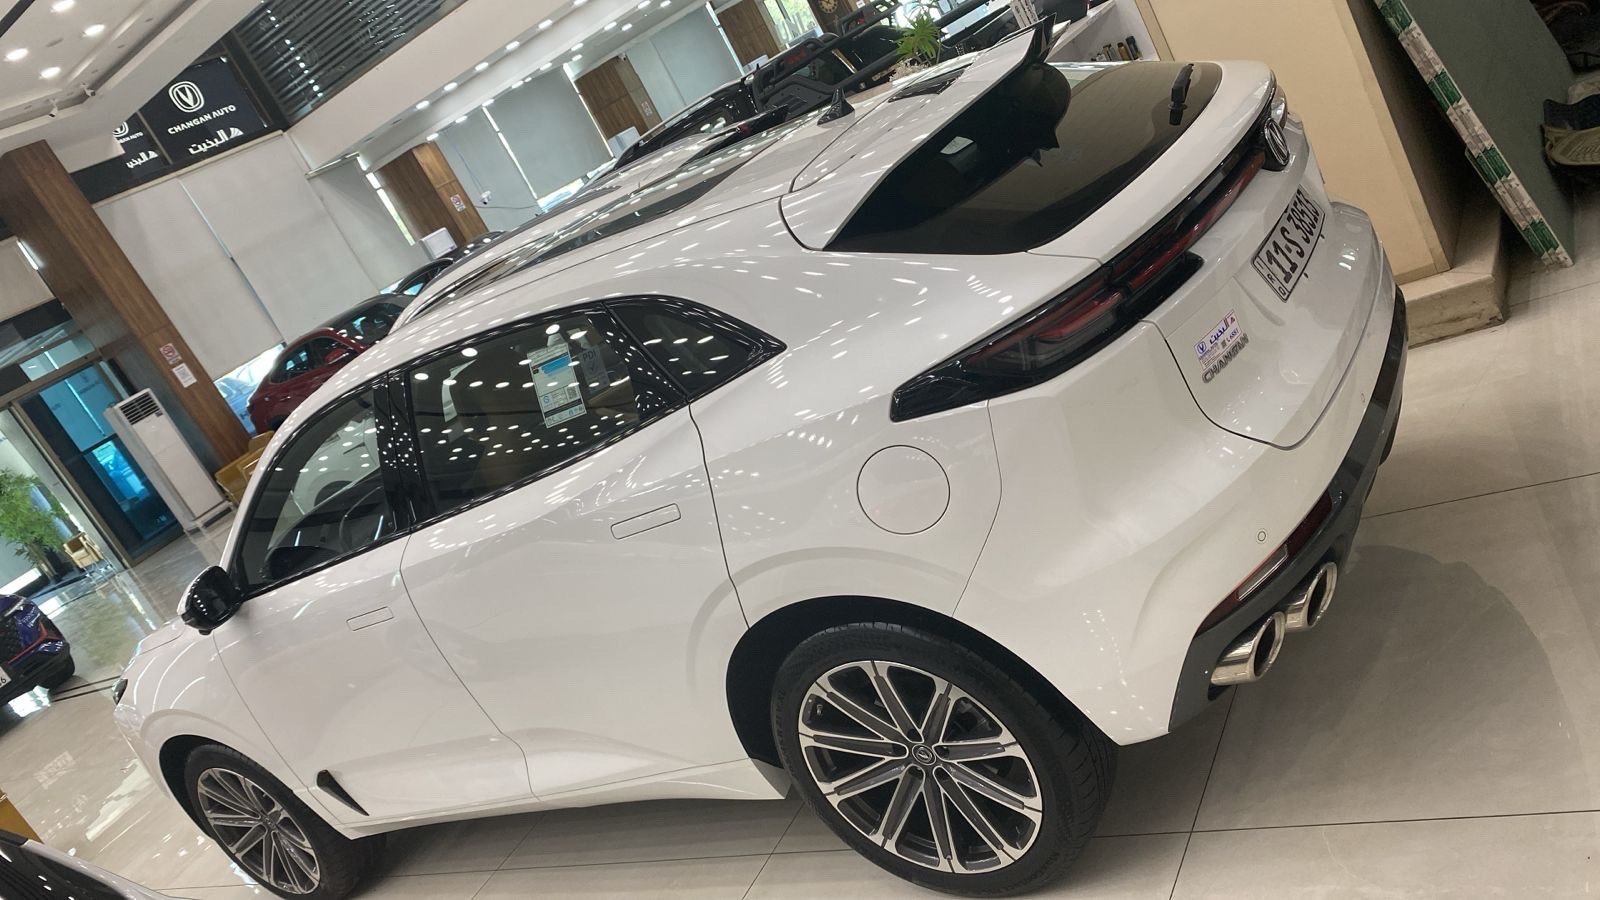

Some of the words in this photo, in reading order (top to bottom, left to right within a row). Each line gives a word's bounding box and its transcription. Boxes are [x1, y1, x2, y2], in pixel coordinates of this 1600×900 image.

[168, 113, 212, 134] CHANGAN
[212, 105, 236, 118] AUTO
[188, 129, 229, 154] البخيت
[1287, 188, 1320, 244] 38513
